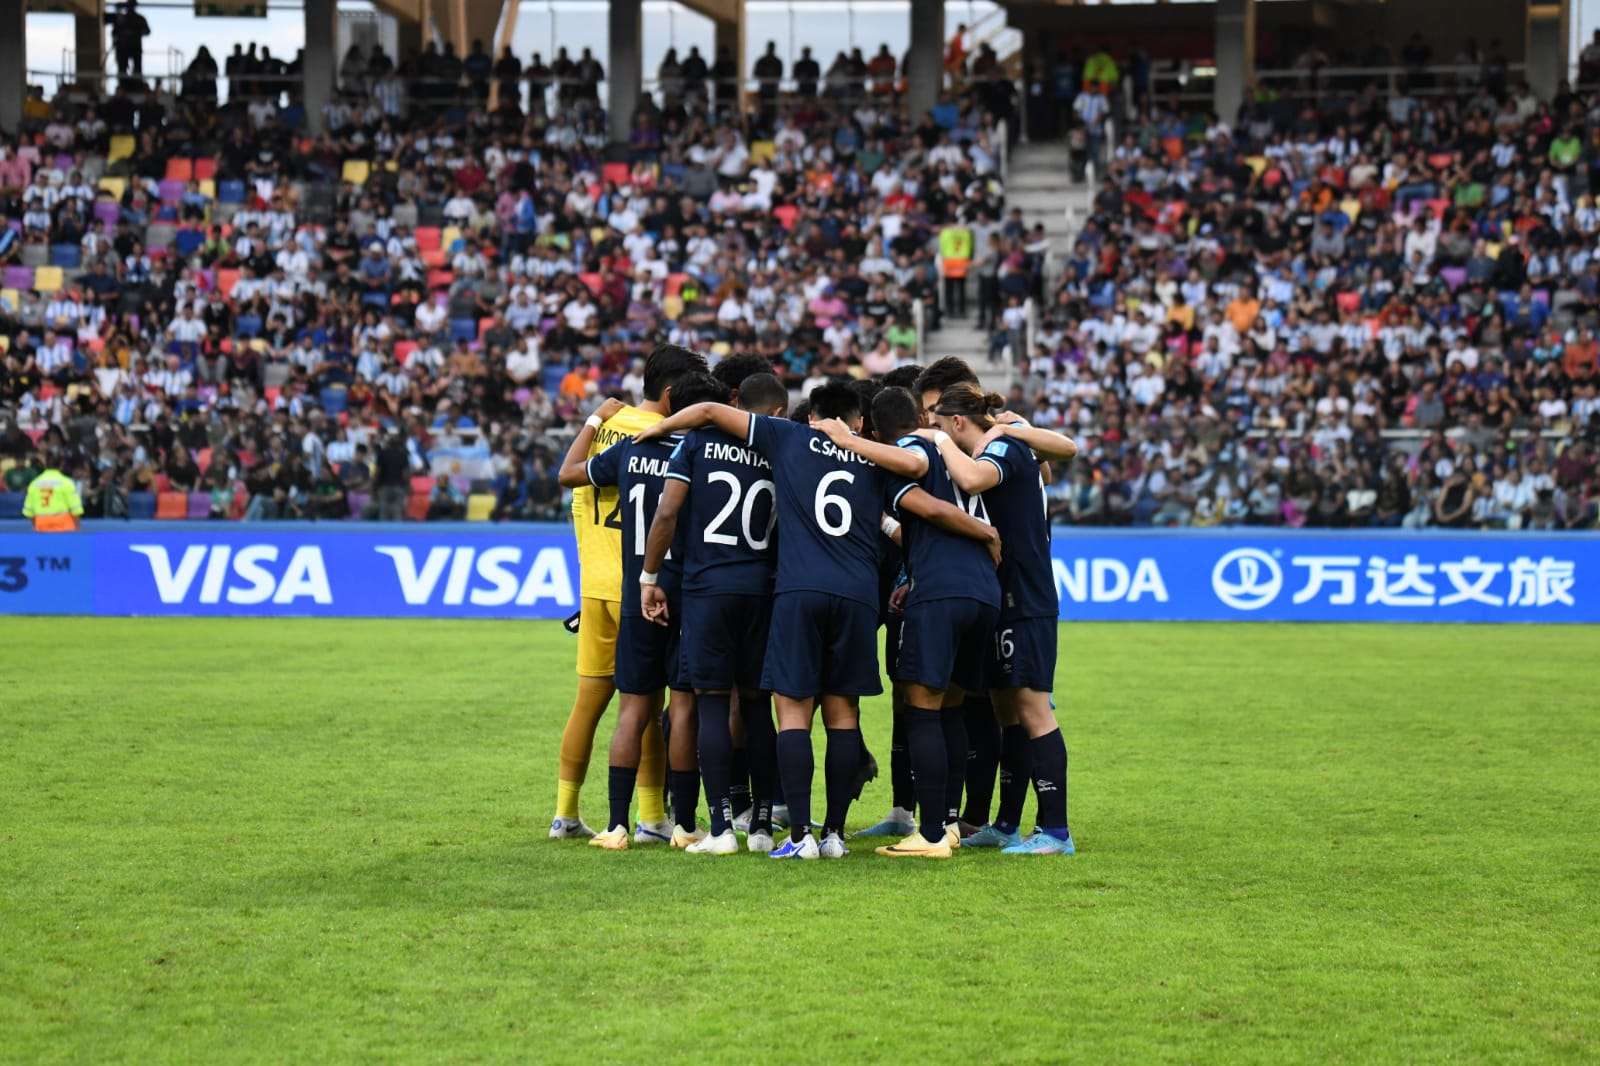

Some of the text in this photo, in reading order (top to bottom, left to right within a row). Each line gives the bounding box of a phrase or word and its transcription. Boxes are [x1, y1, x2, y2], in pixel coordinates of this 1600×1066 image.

[704, 442, 773, 470] F.MONTA
[703, 470, 777, 551] 20
[815, 470, 855, 537] 6
[129, 544, 333, 605] VISA
[374, 545, 575, 606] VISA
[1292, 554, 1575, 607] 万达文旅
